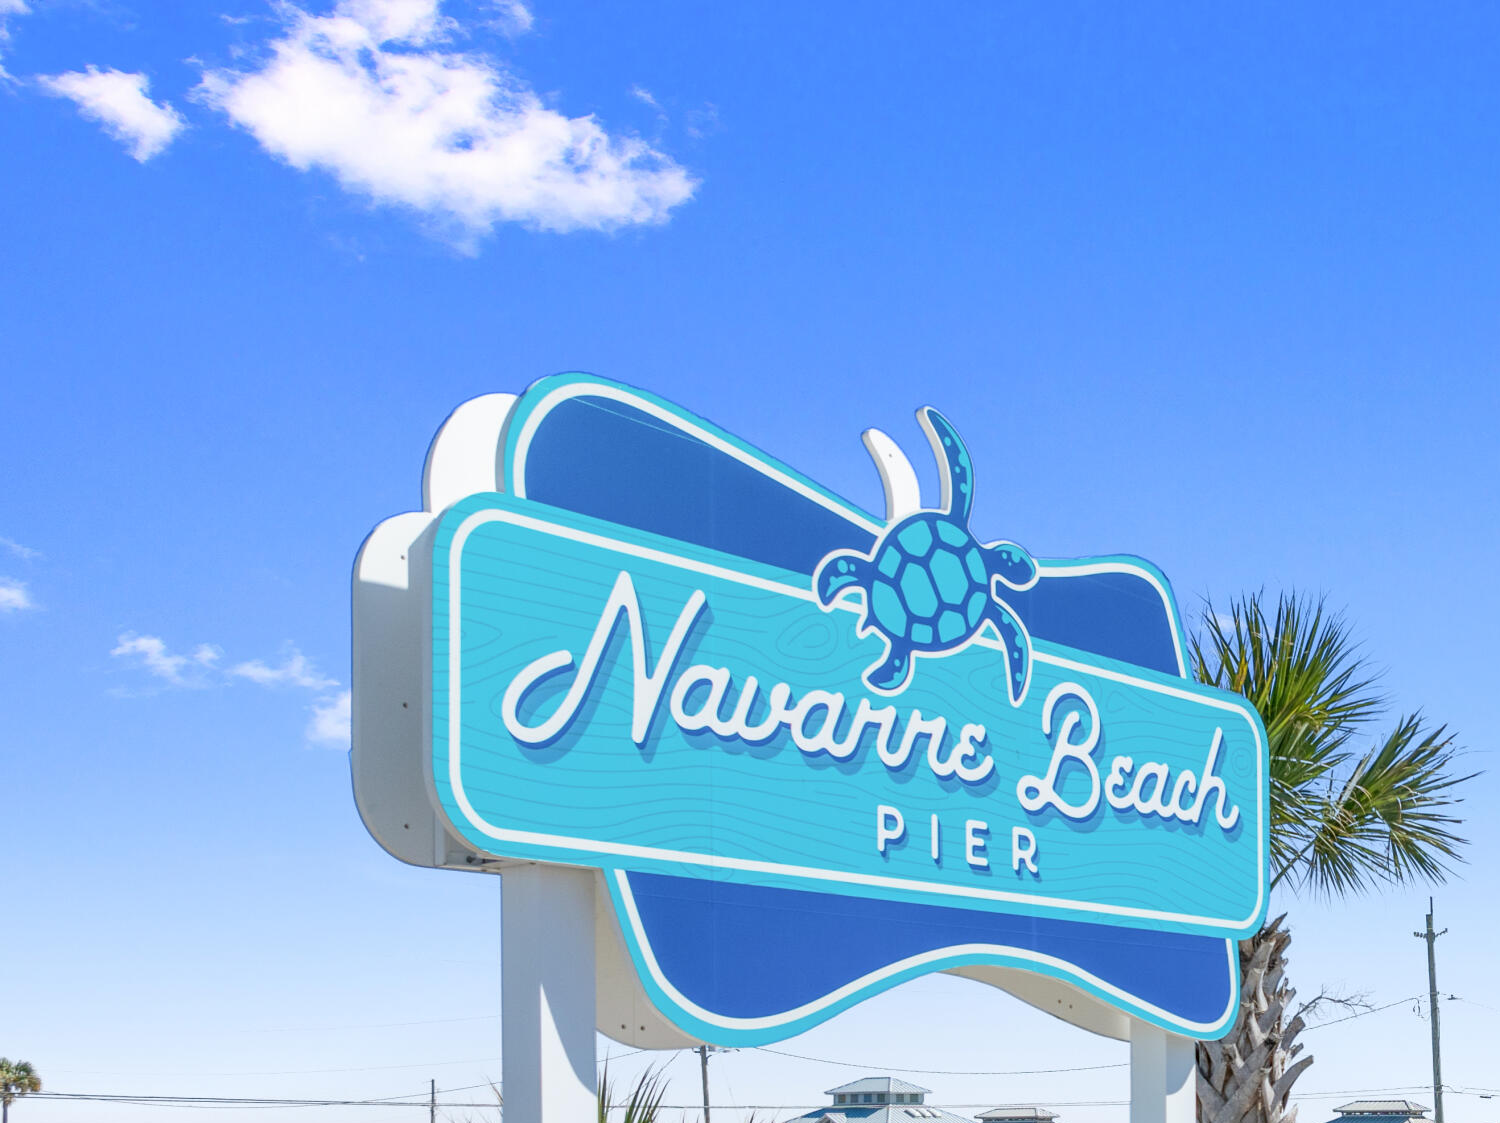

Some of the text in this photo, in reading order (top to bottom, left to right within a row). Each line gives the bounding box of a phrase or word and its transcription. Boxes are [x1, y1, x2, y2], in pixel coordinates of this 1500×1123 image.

[502, 571, 1240, 830] Navarre Beach
[878, 804, 1039, 874] PIER
